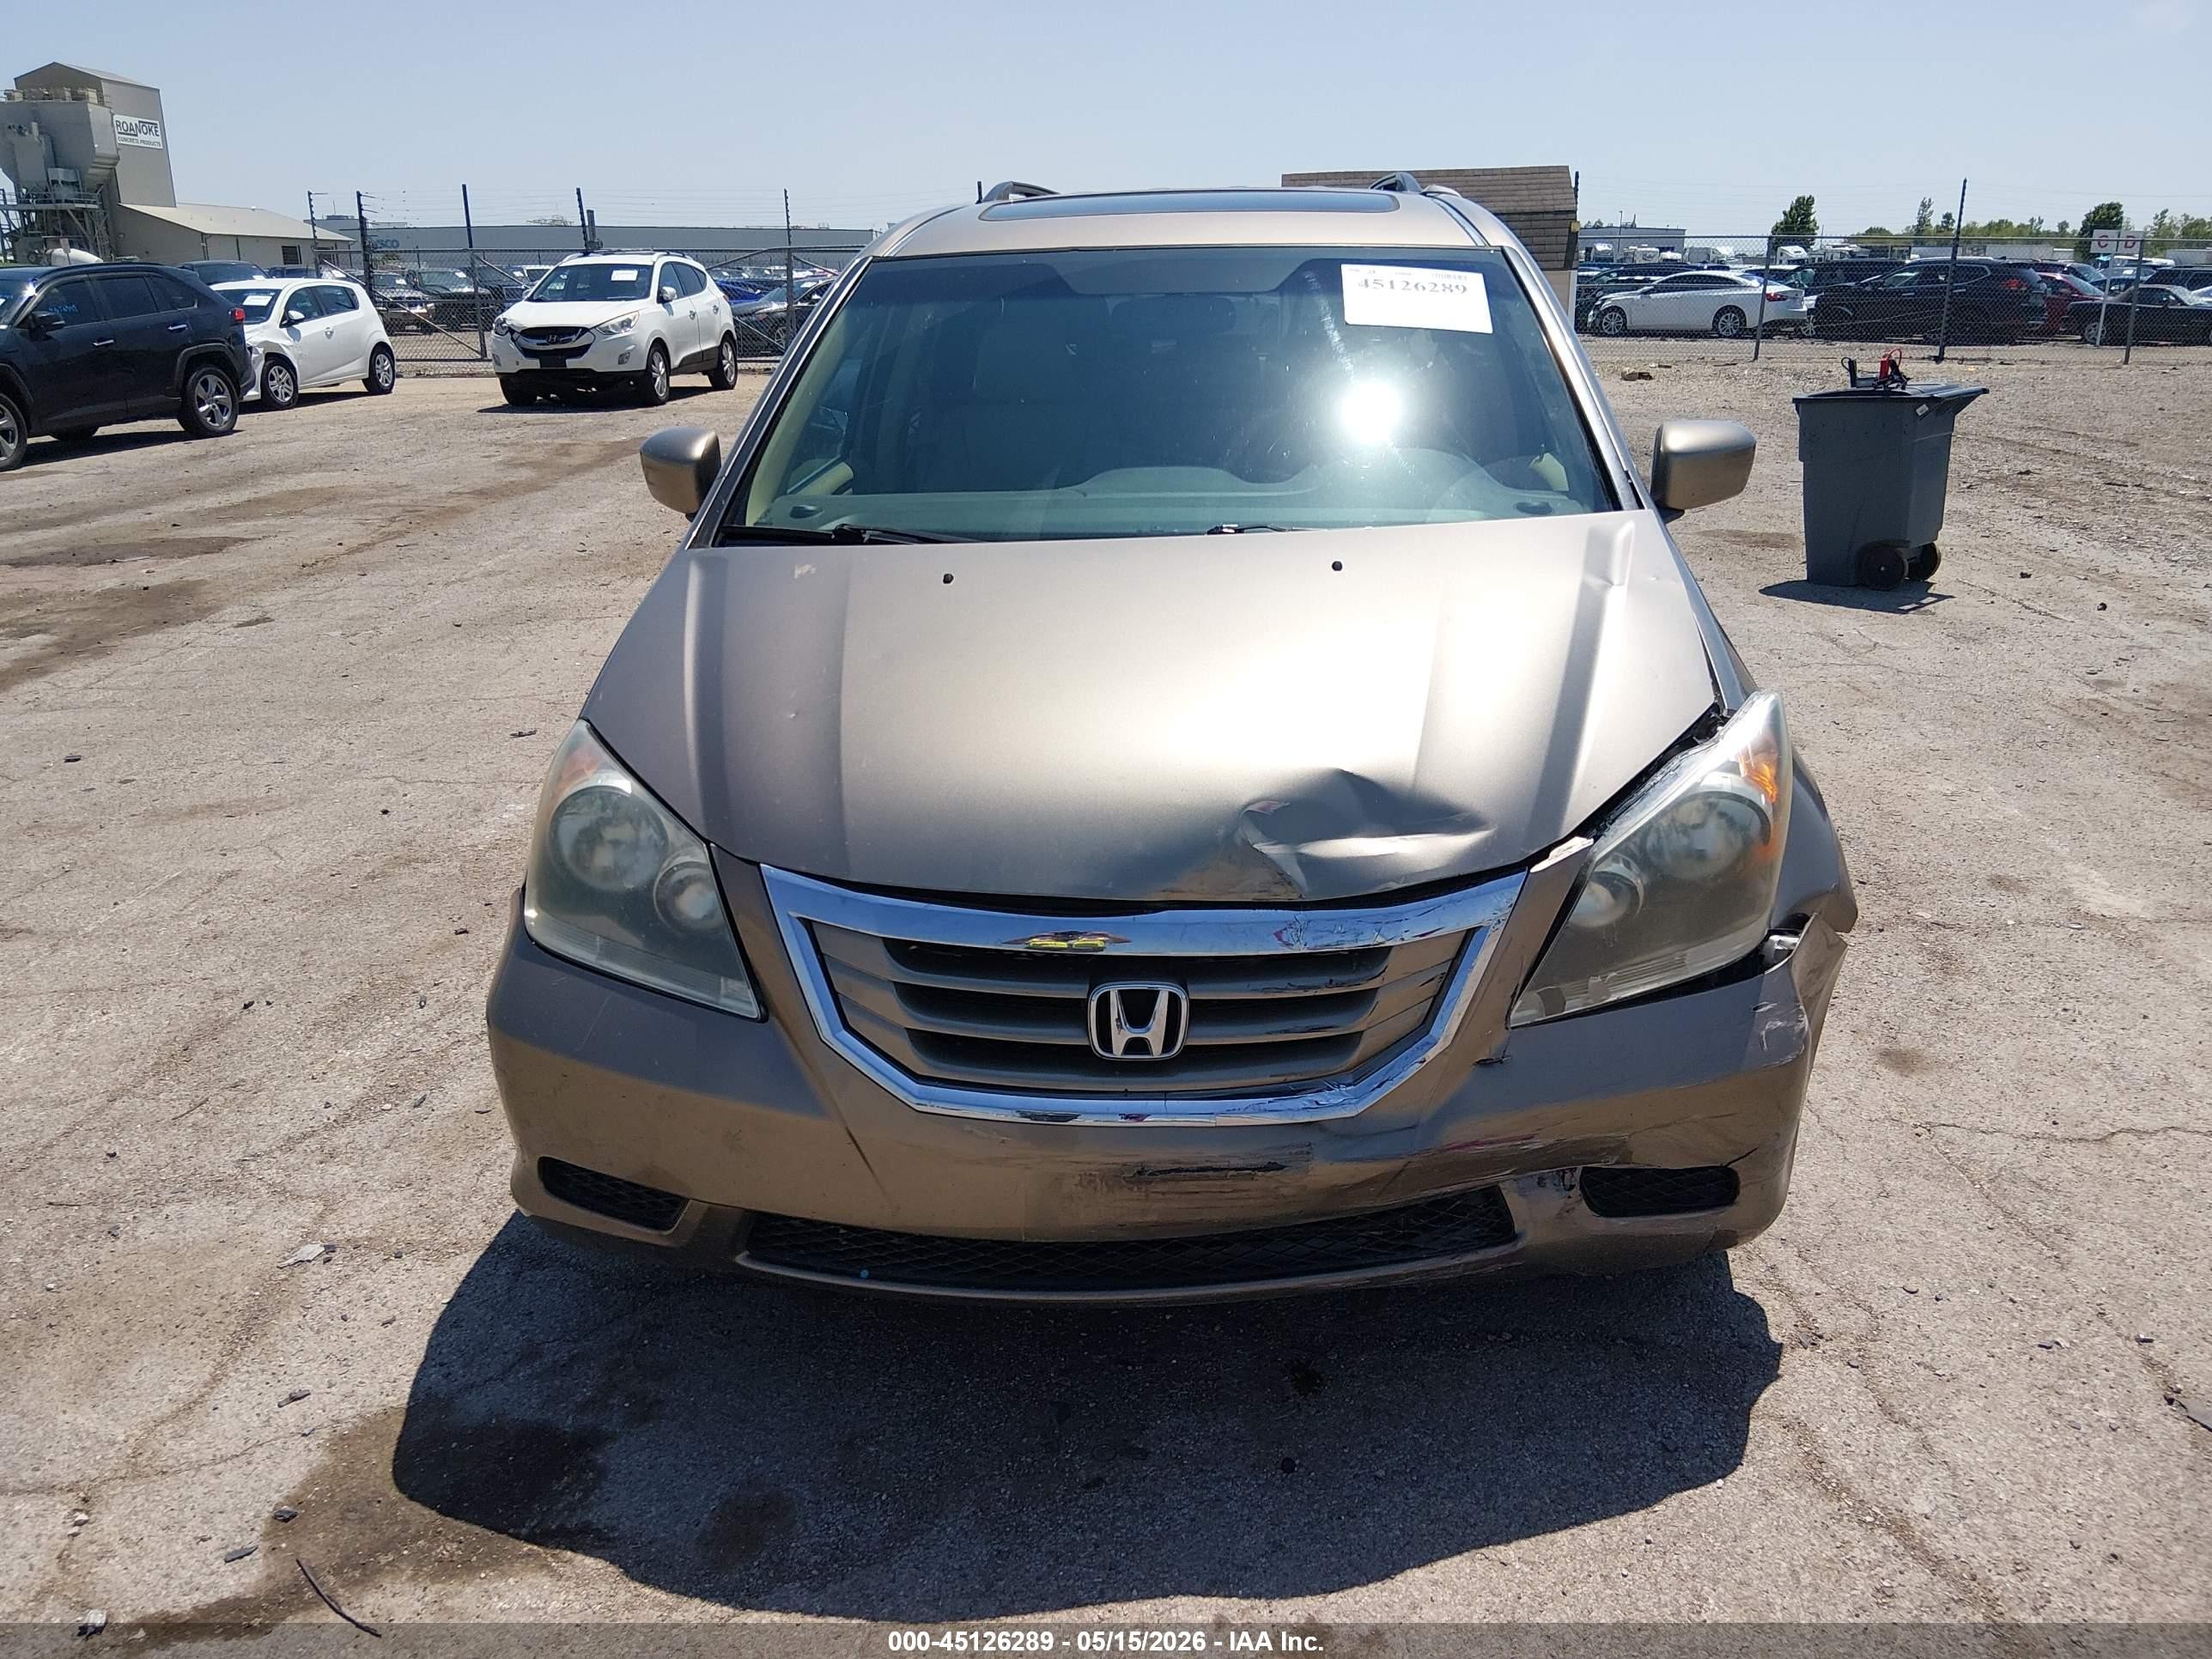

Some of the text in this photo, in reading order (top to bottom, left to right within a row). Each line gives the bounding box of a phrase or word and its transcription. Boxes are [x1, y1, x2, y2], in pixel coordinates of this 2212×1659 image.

[115, 120, 160, 137] ROANOKE
[2098, 234, 2109, 248] C
[2124, 234, 2136, 248] D
[1358, 277, 1468, 294] 45126289
